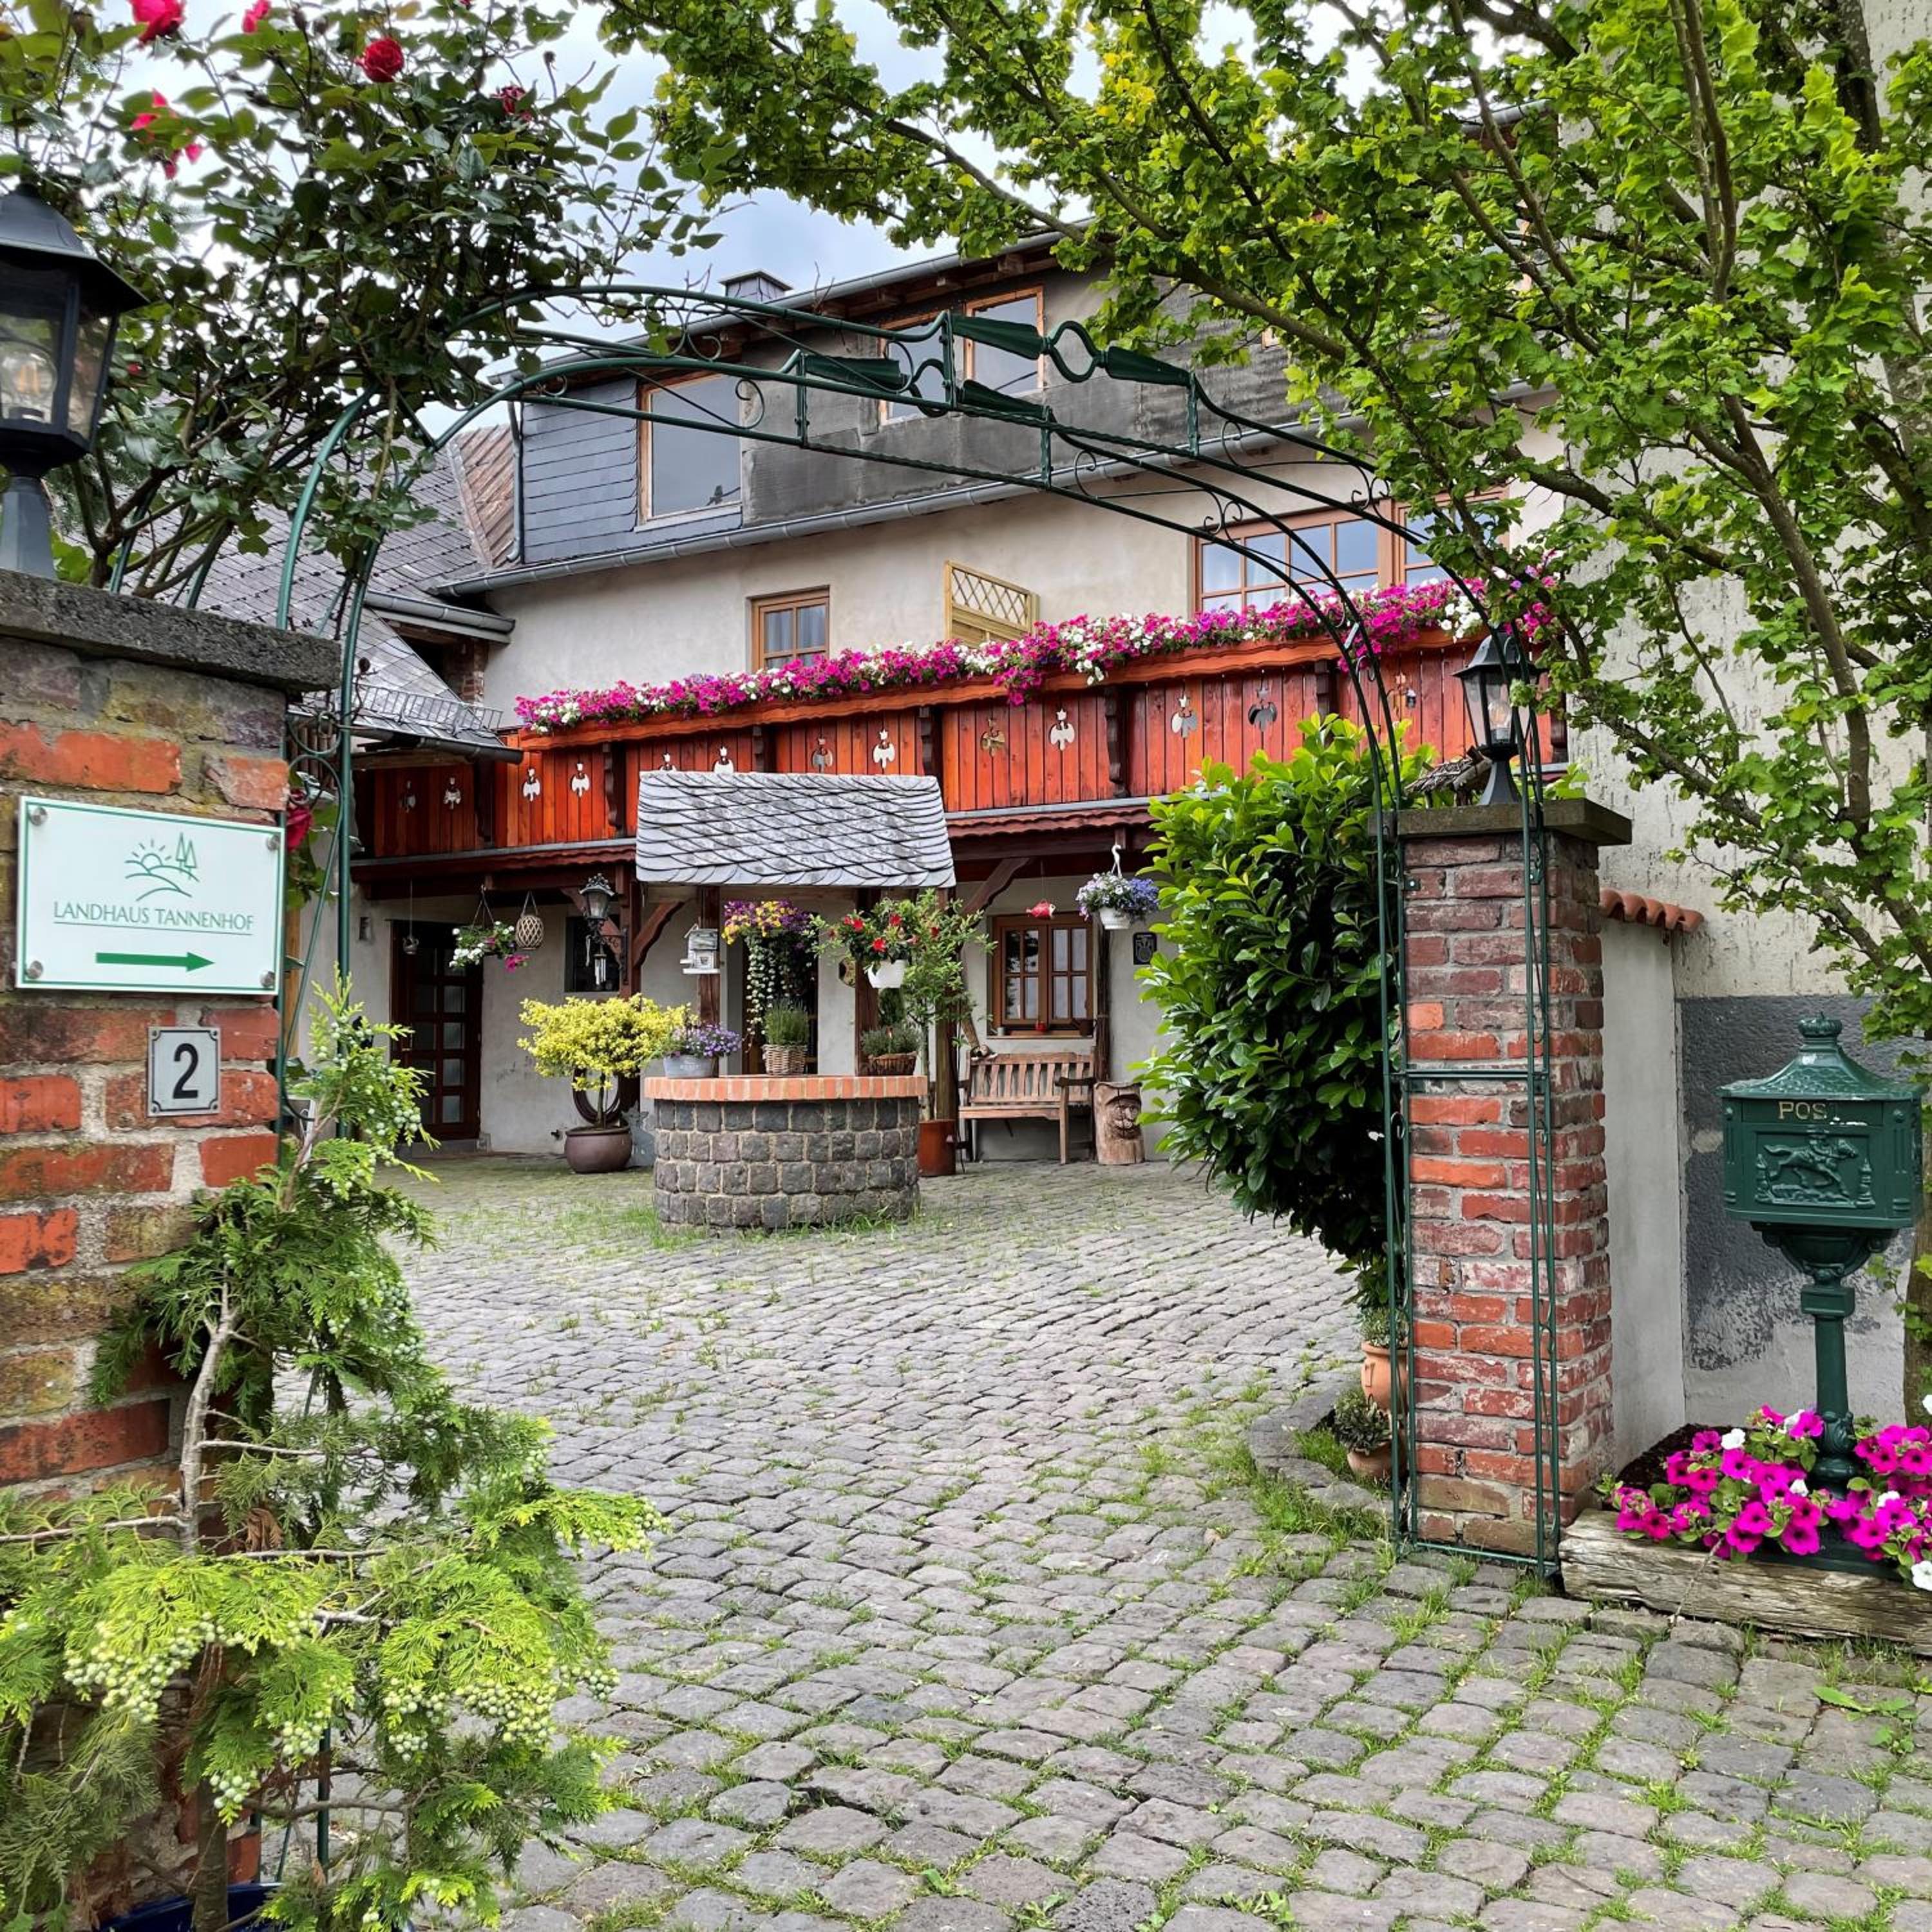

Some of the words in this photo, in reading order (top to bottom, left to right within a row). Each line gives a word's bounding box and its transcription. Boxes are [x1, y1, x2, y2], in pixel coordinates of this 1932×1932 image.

[54, 902, 149, 923] LANDHAUS
[155, 908, 254, 930] TANNENHOF
[173, 1043, 199, 1099] 2
